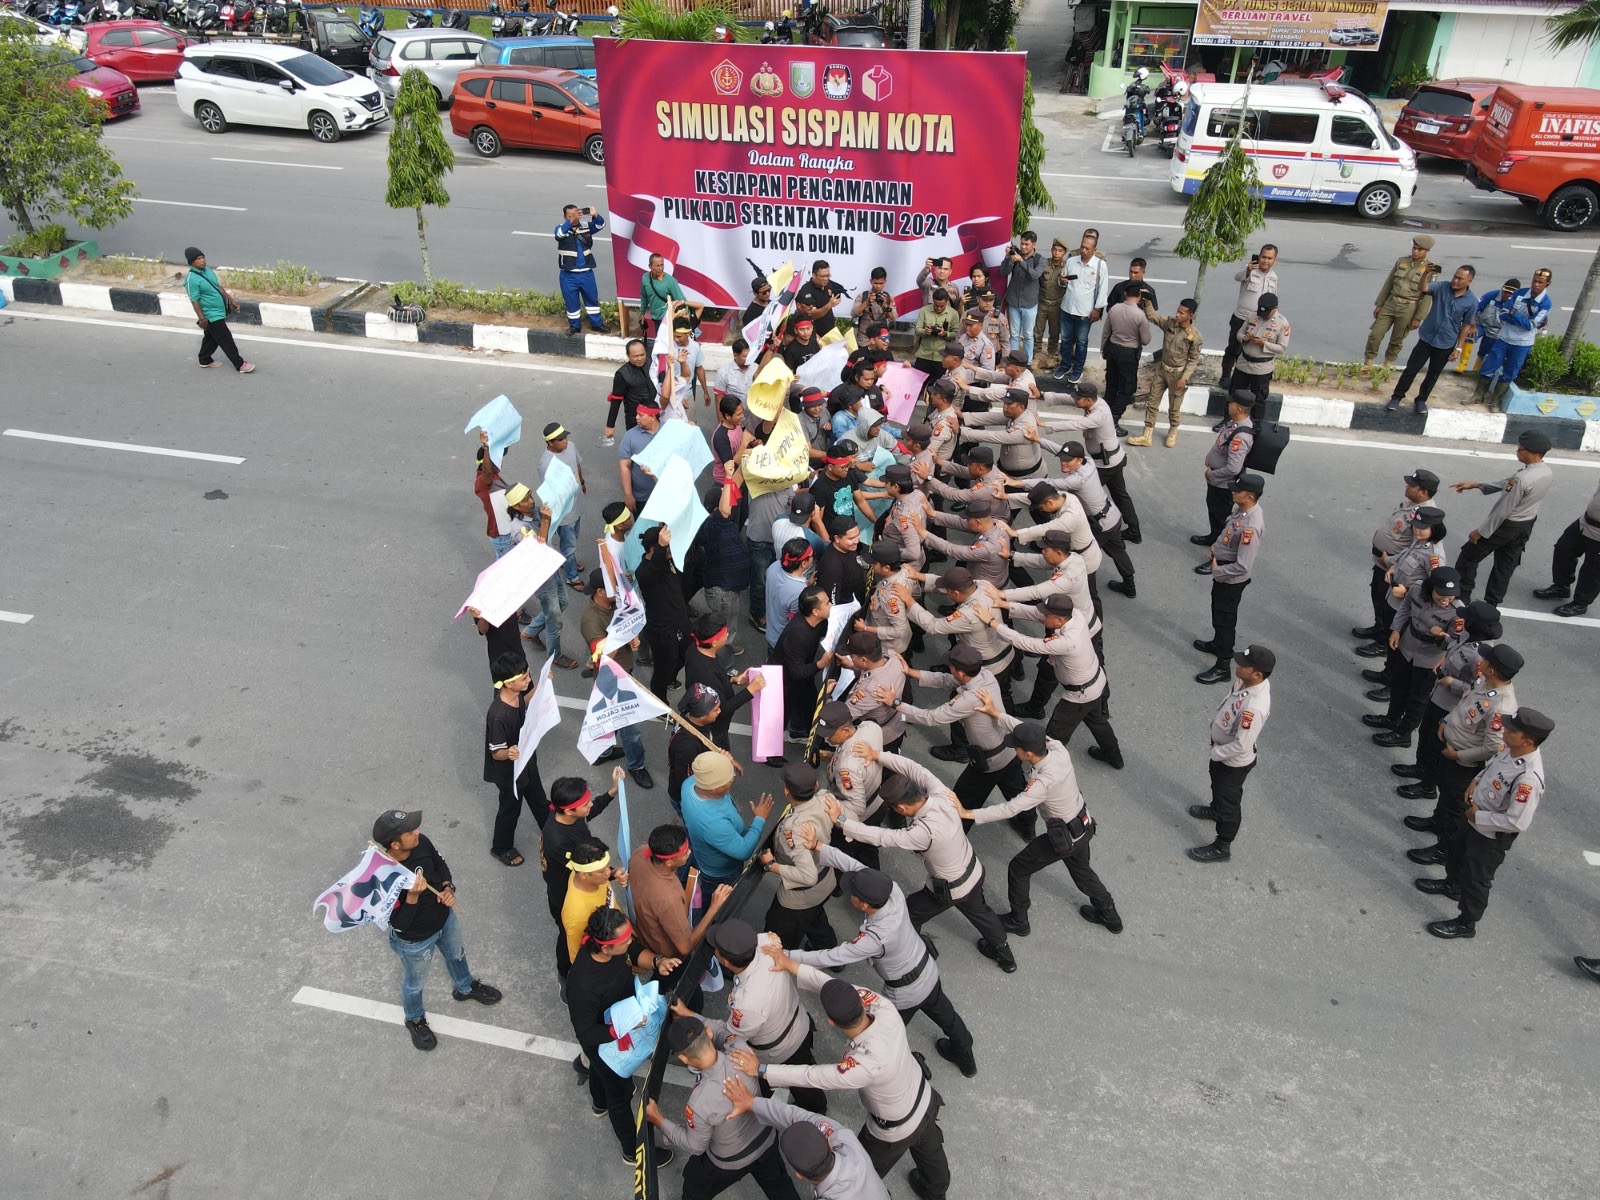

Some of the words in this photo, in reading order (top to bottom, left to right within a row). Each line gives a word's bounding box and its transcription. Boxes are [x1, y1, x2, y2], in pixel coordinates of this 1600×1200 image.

[1221, 11, 1268, 21] BERLIAN
[1270, 12, 1312, 22] TRAVEL
[1244, 0, 1278, 11] TUNAS
[1279, 1, 1326, 13] BERLIAN
[1327, 2, 1378, 14] MANDIRI
[1490, 102, 1513, 127] POLISI
[656, 100, 774, 144] SIMULASI
[781, 106, 879, 150] SISPAM
[887, 112, 955, 153] KOTA
[1539, 118, 1600, 135] INAFIS
[748, 149, 796, 169] Dalam
[798, 152, 855, 174] Rangka
[695, 170, 782, 198] KESIAPAN
[787, 175, 912, 206] PENGAMANAN
[1271, 188, 1293, 196] Dumai
[663, 198, 736, 224] PILKADA
[739, 201, 829, 230] SERENTAK
[834, 207, 894, 235] TAHUN
[899, 213, 949, 238] 2024
[751, 229, 766, 249] DI
[769, 230, 806, 252] KOTA
[808, 233, 855, 256] DUMAI
[1475, 701, 1485, 715] POLRI
[1498, 772, 1510, 787] POLRI
